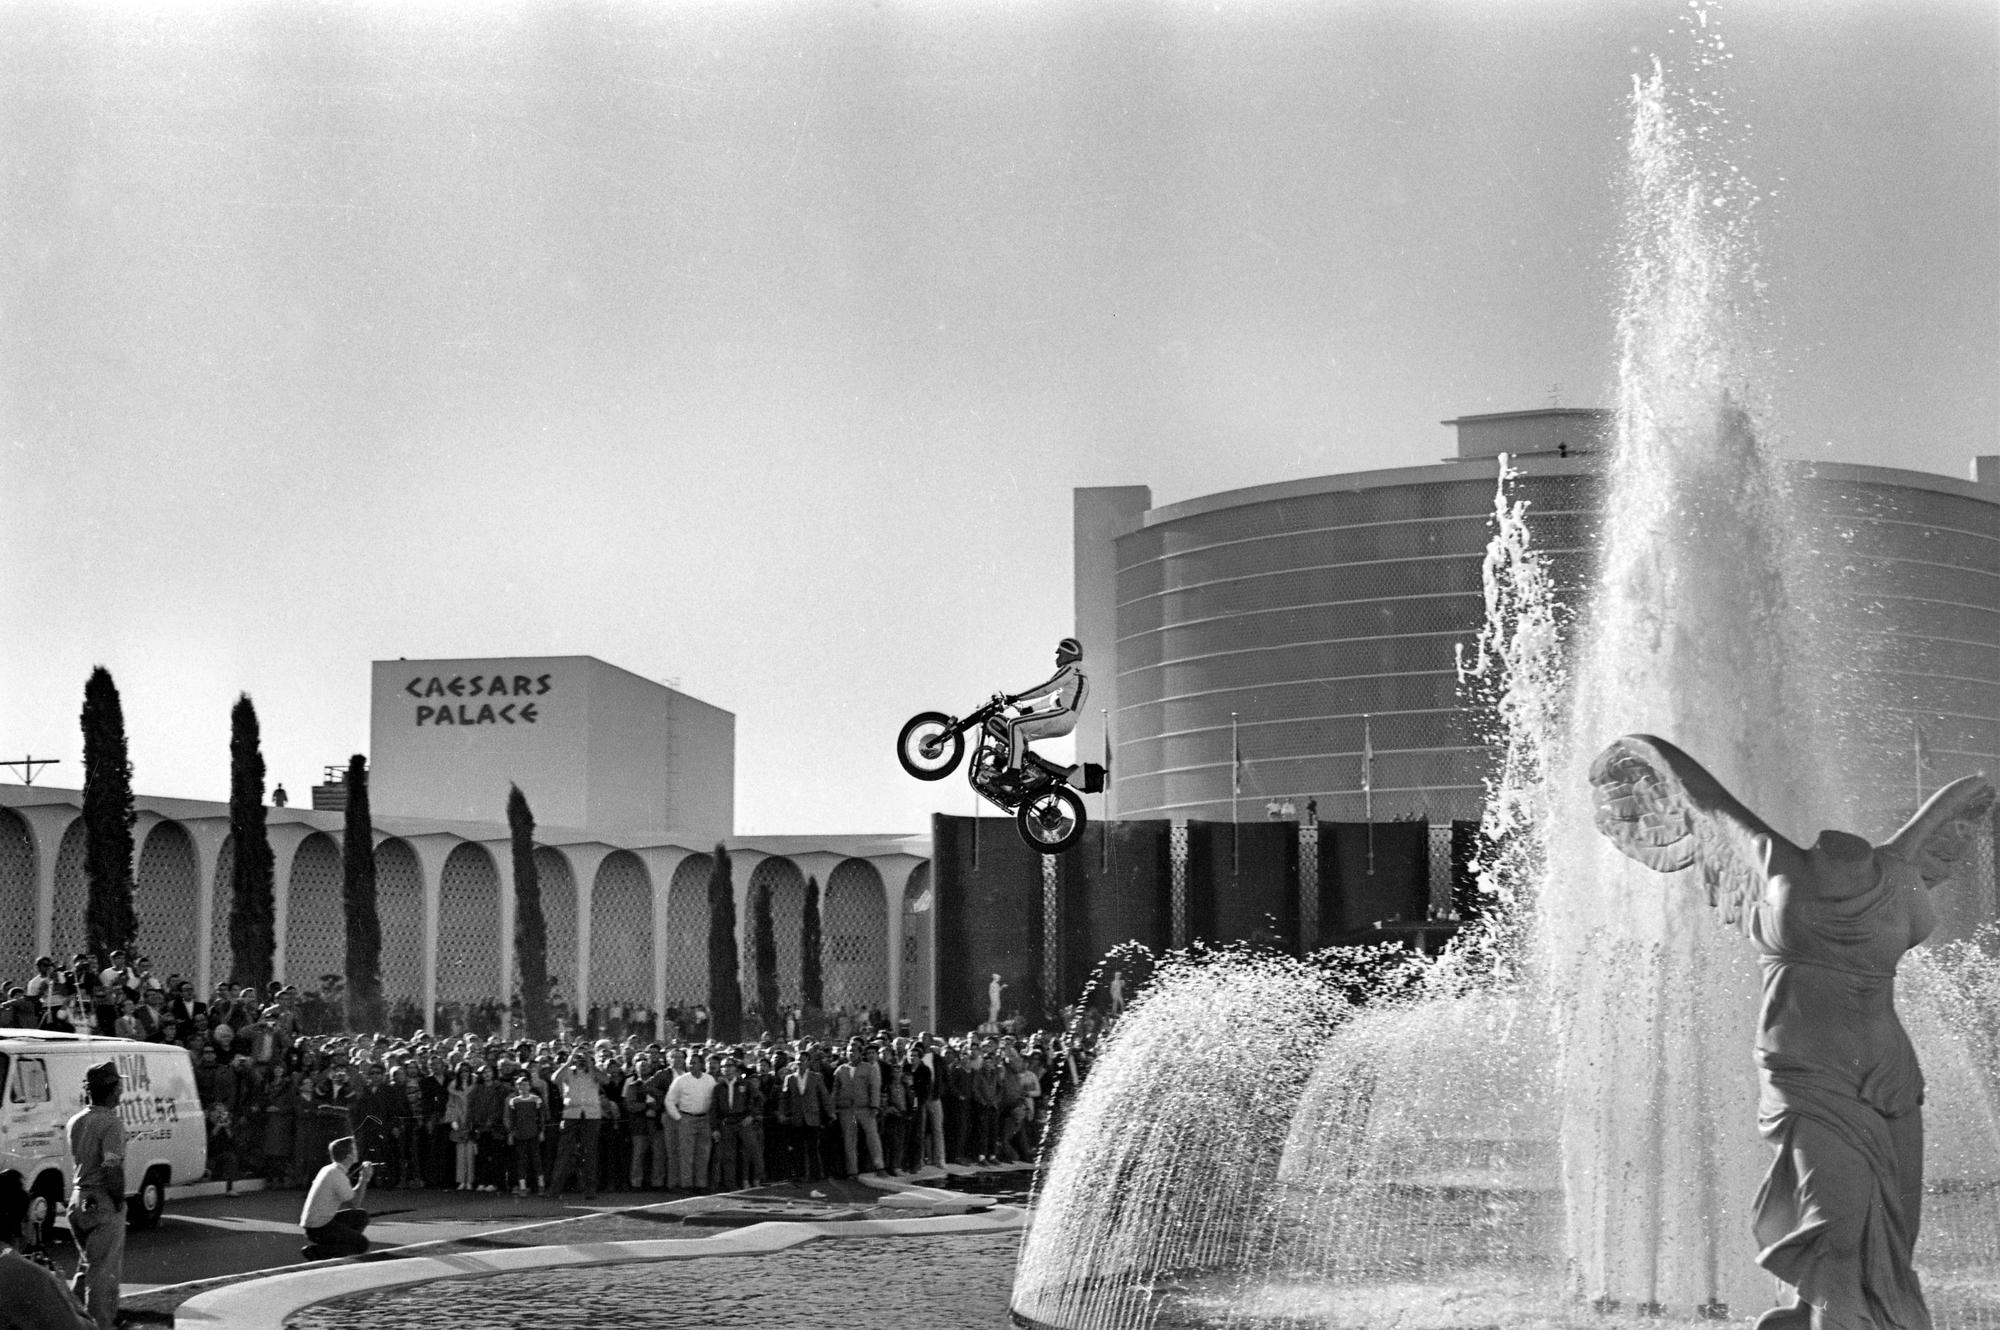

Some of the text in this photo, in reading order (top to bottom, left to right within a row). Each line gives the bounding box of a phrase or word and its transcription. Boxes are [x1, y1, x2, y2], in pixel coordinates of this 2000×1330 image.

[405, 673, 551, 698] CAESARS
[416, 702, 538, 727] PALACE
[119, 1095, 179, 1126] ntesa
